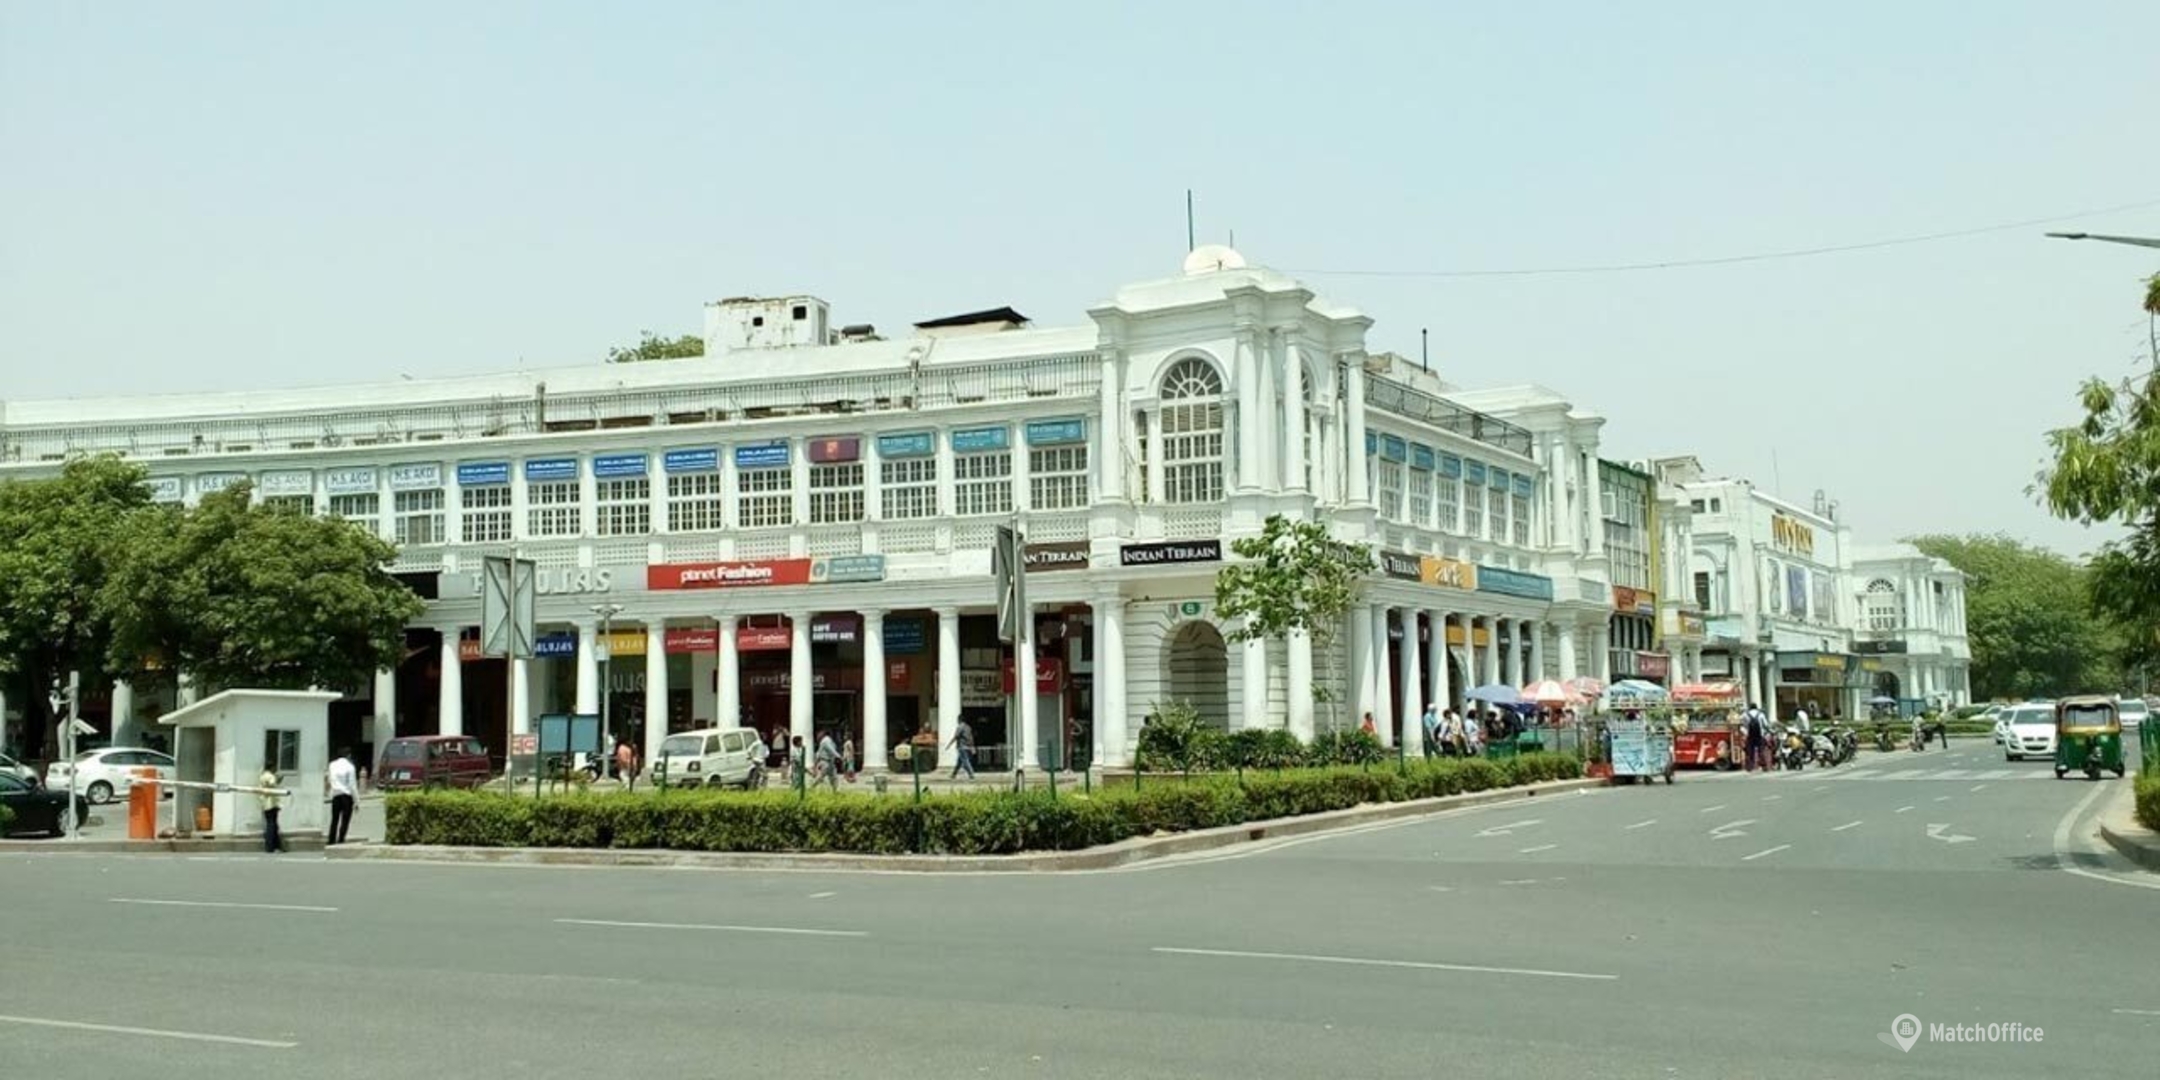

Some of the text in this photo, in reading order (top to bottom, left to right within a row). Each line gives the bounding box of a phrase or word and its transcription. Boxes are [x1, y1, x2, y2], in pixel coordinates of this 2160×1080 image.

[1041, 550, 1088, 563] TERRAIN
[1123, 546, 1217, 562] INDIAN TERRAIN
[716, 563, 773, 580] Fashion
